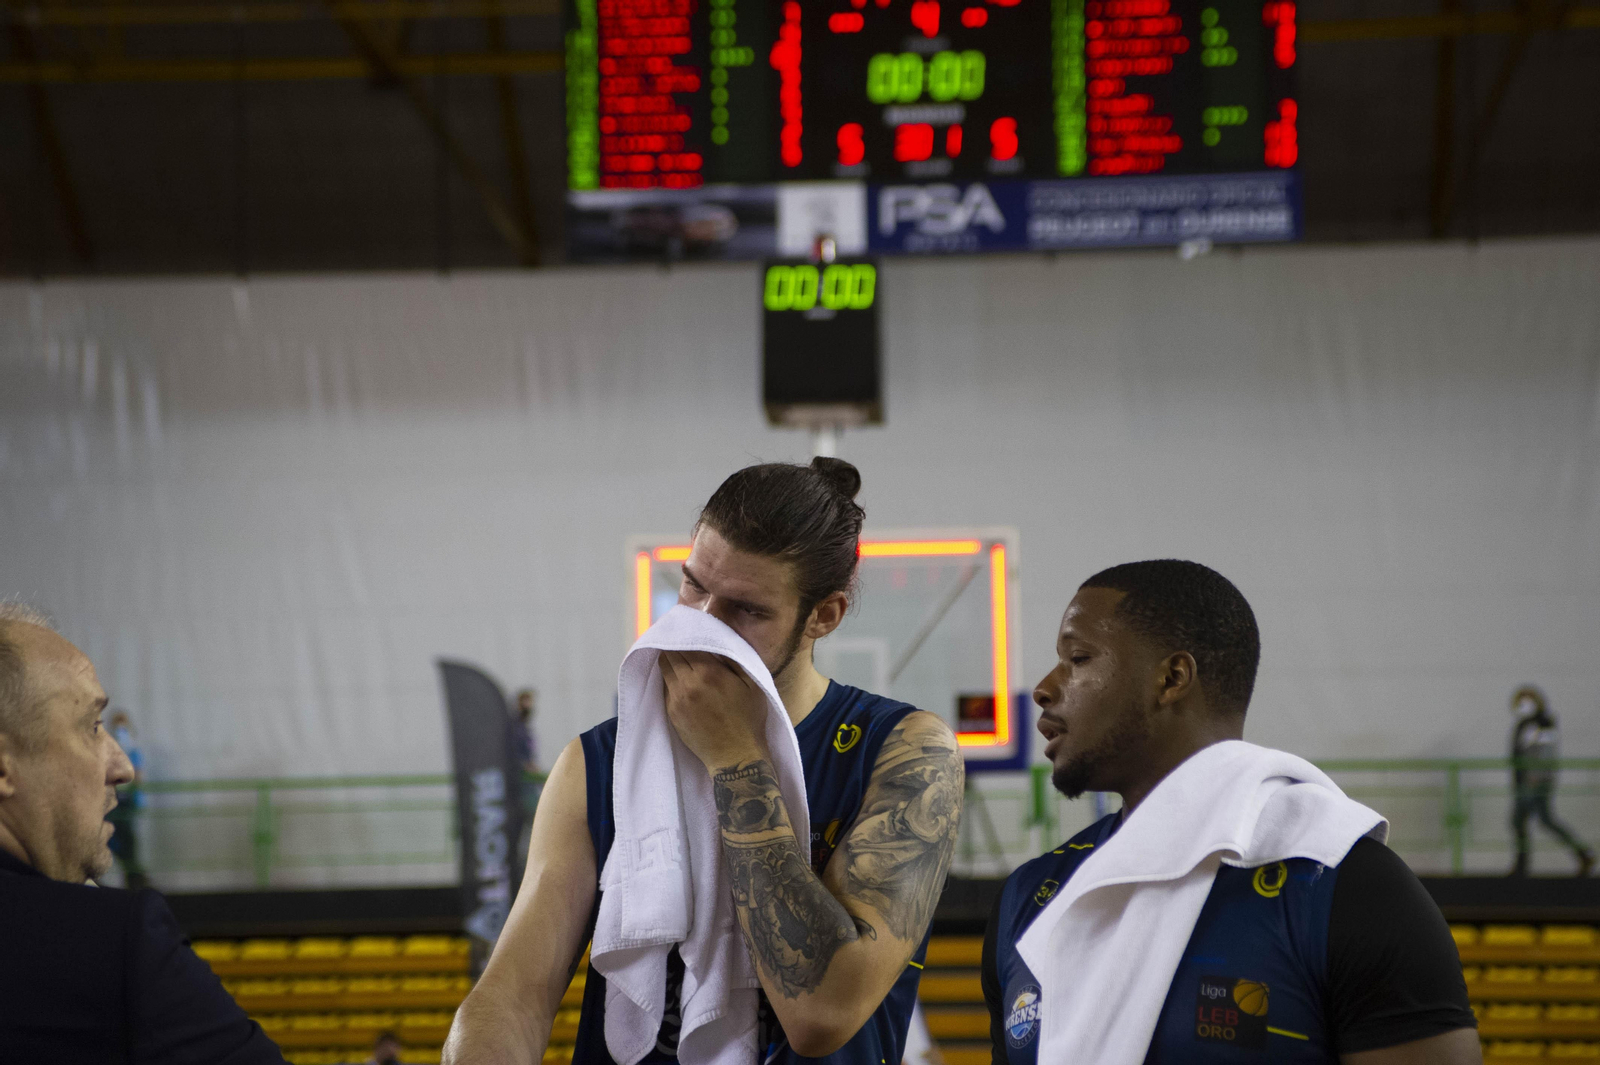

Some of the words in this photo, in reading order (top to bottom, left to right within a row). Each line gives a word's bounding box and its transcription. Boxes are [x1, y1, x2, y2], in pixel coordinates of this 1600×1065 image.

[878, 184, 1004, 235] PSA
[1201, 983, 1227, 1000] Liga
[1198, 1006, 1239, 1026] LEB
[1197, 1024, 1236, 1041] ORO
